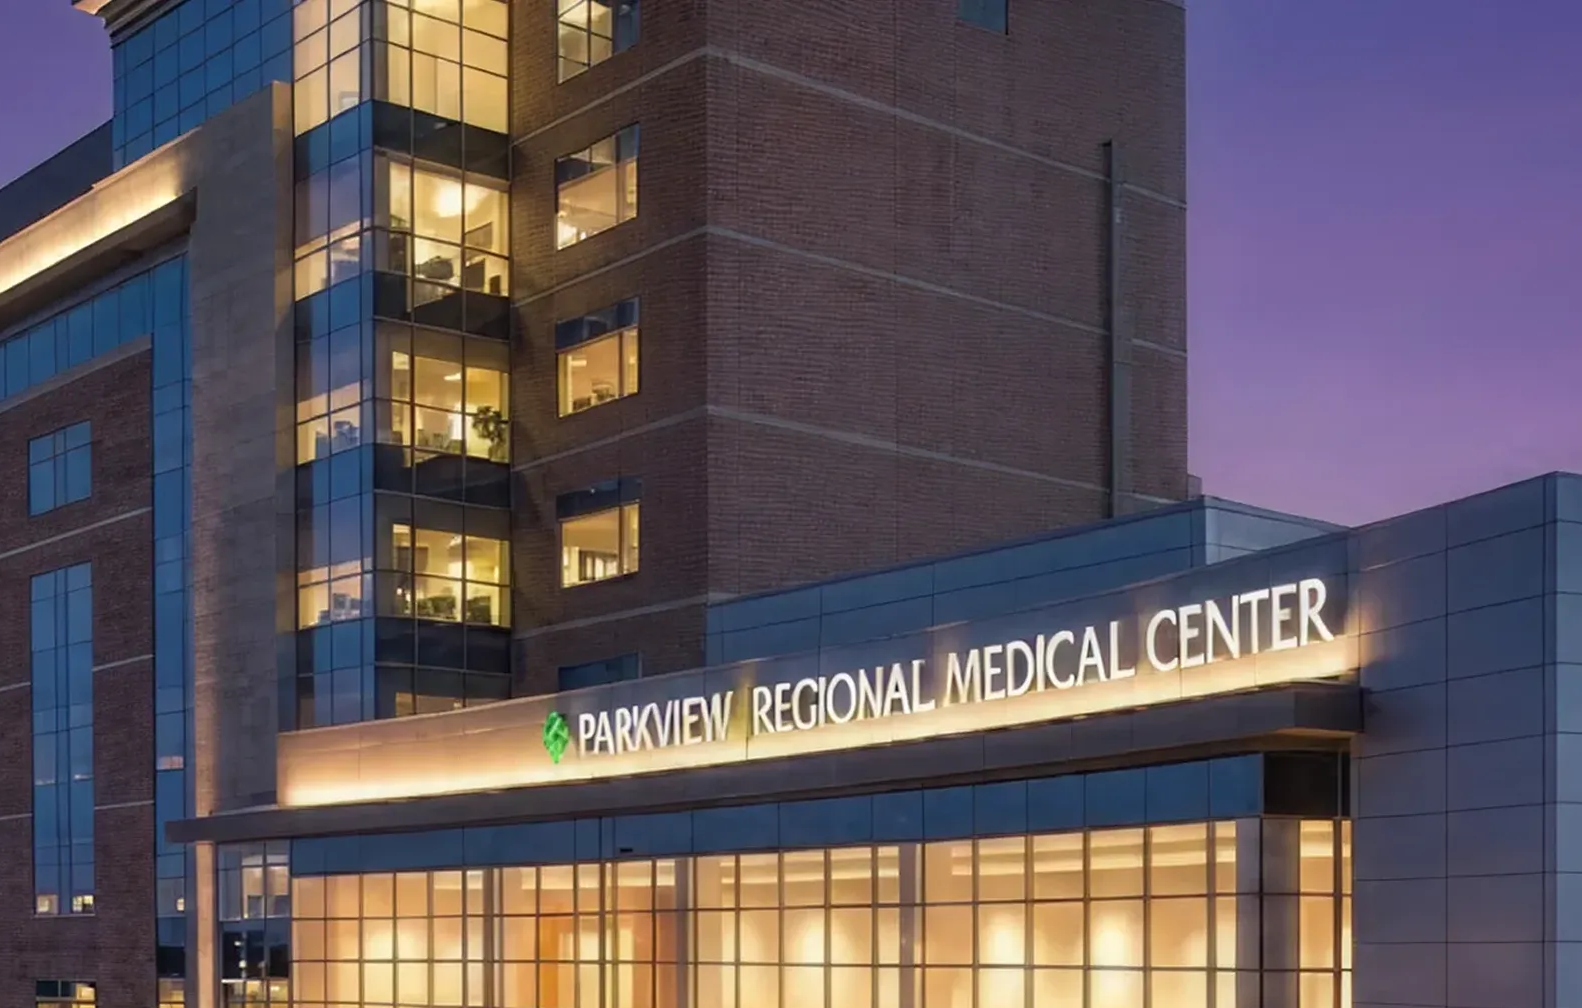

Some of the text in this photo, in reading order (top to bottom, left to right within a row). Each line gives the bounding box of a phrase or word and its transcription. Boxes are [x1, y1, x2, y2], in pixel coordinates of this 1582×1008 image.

[579, 578, 1334, 754] PARKVIEW REGIONAL MEDICAL CENTER
